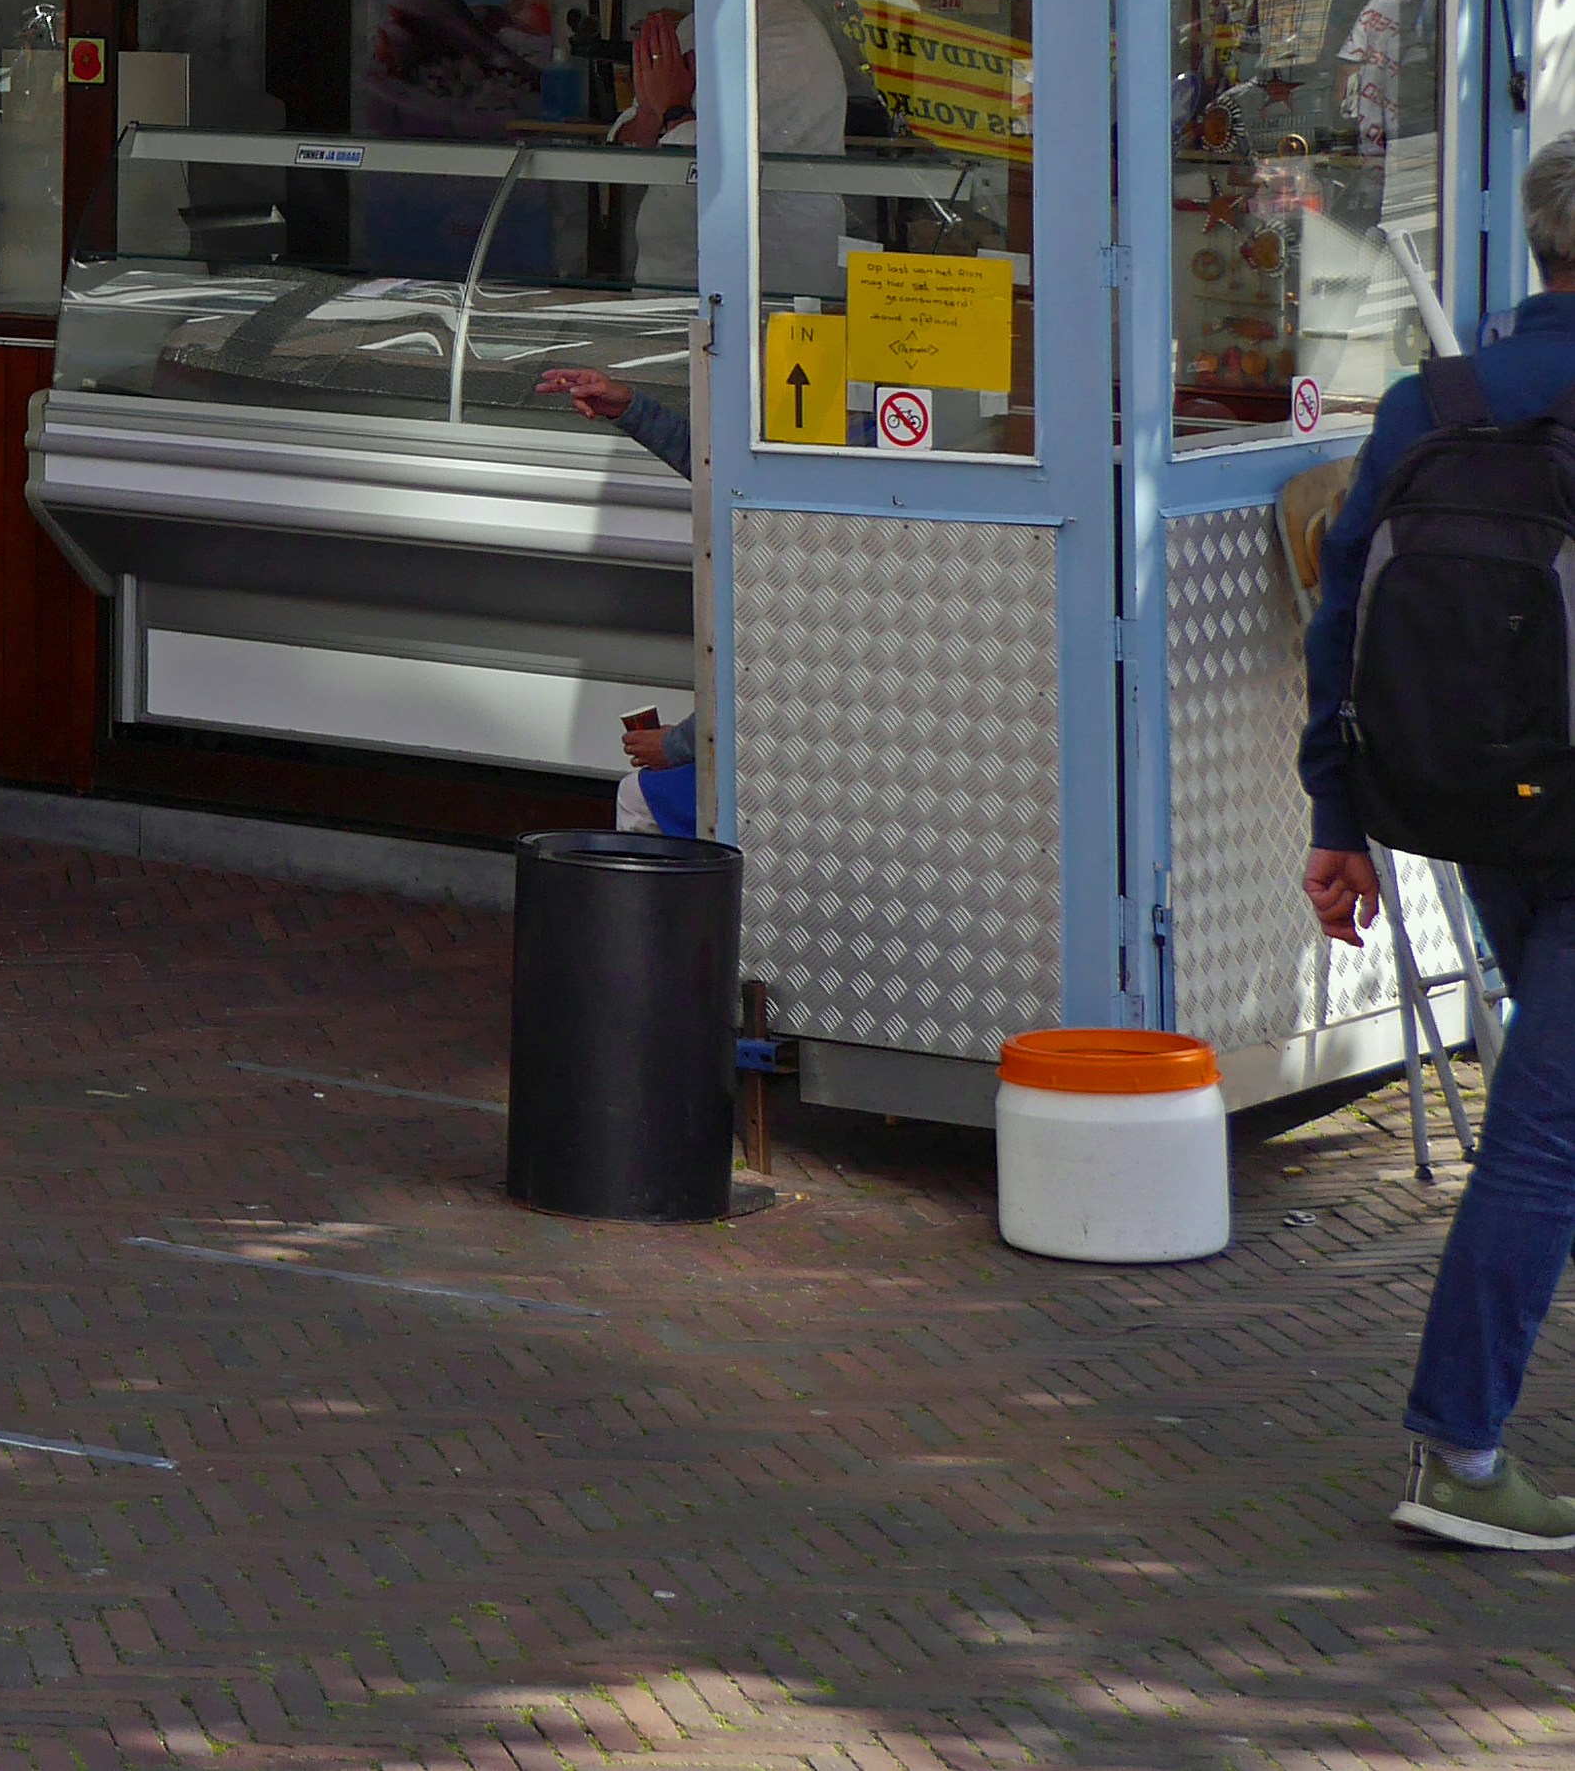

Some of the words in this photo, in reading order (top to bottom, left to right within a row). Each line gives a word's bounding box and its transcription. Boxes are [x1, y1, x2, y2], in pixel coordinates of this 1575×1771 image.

[887, 262, 908, 274] last
[936, 267, 951, 276] het
[791, 325, 813, 342] IN
